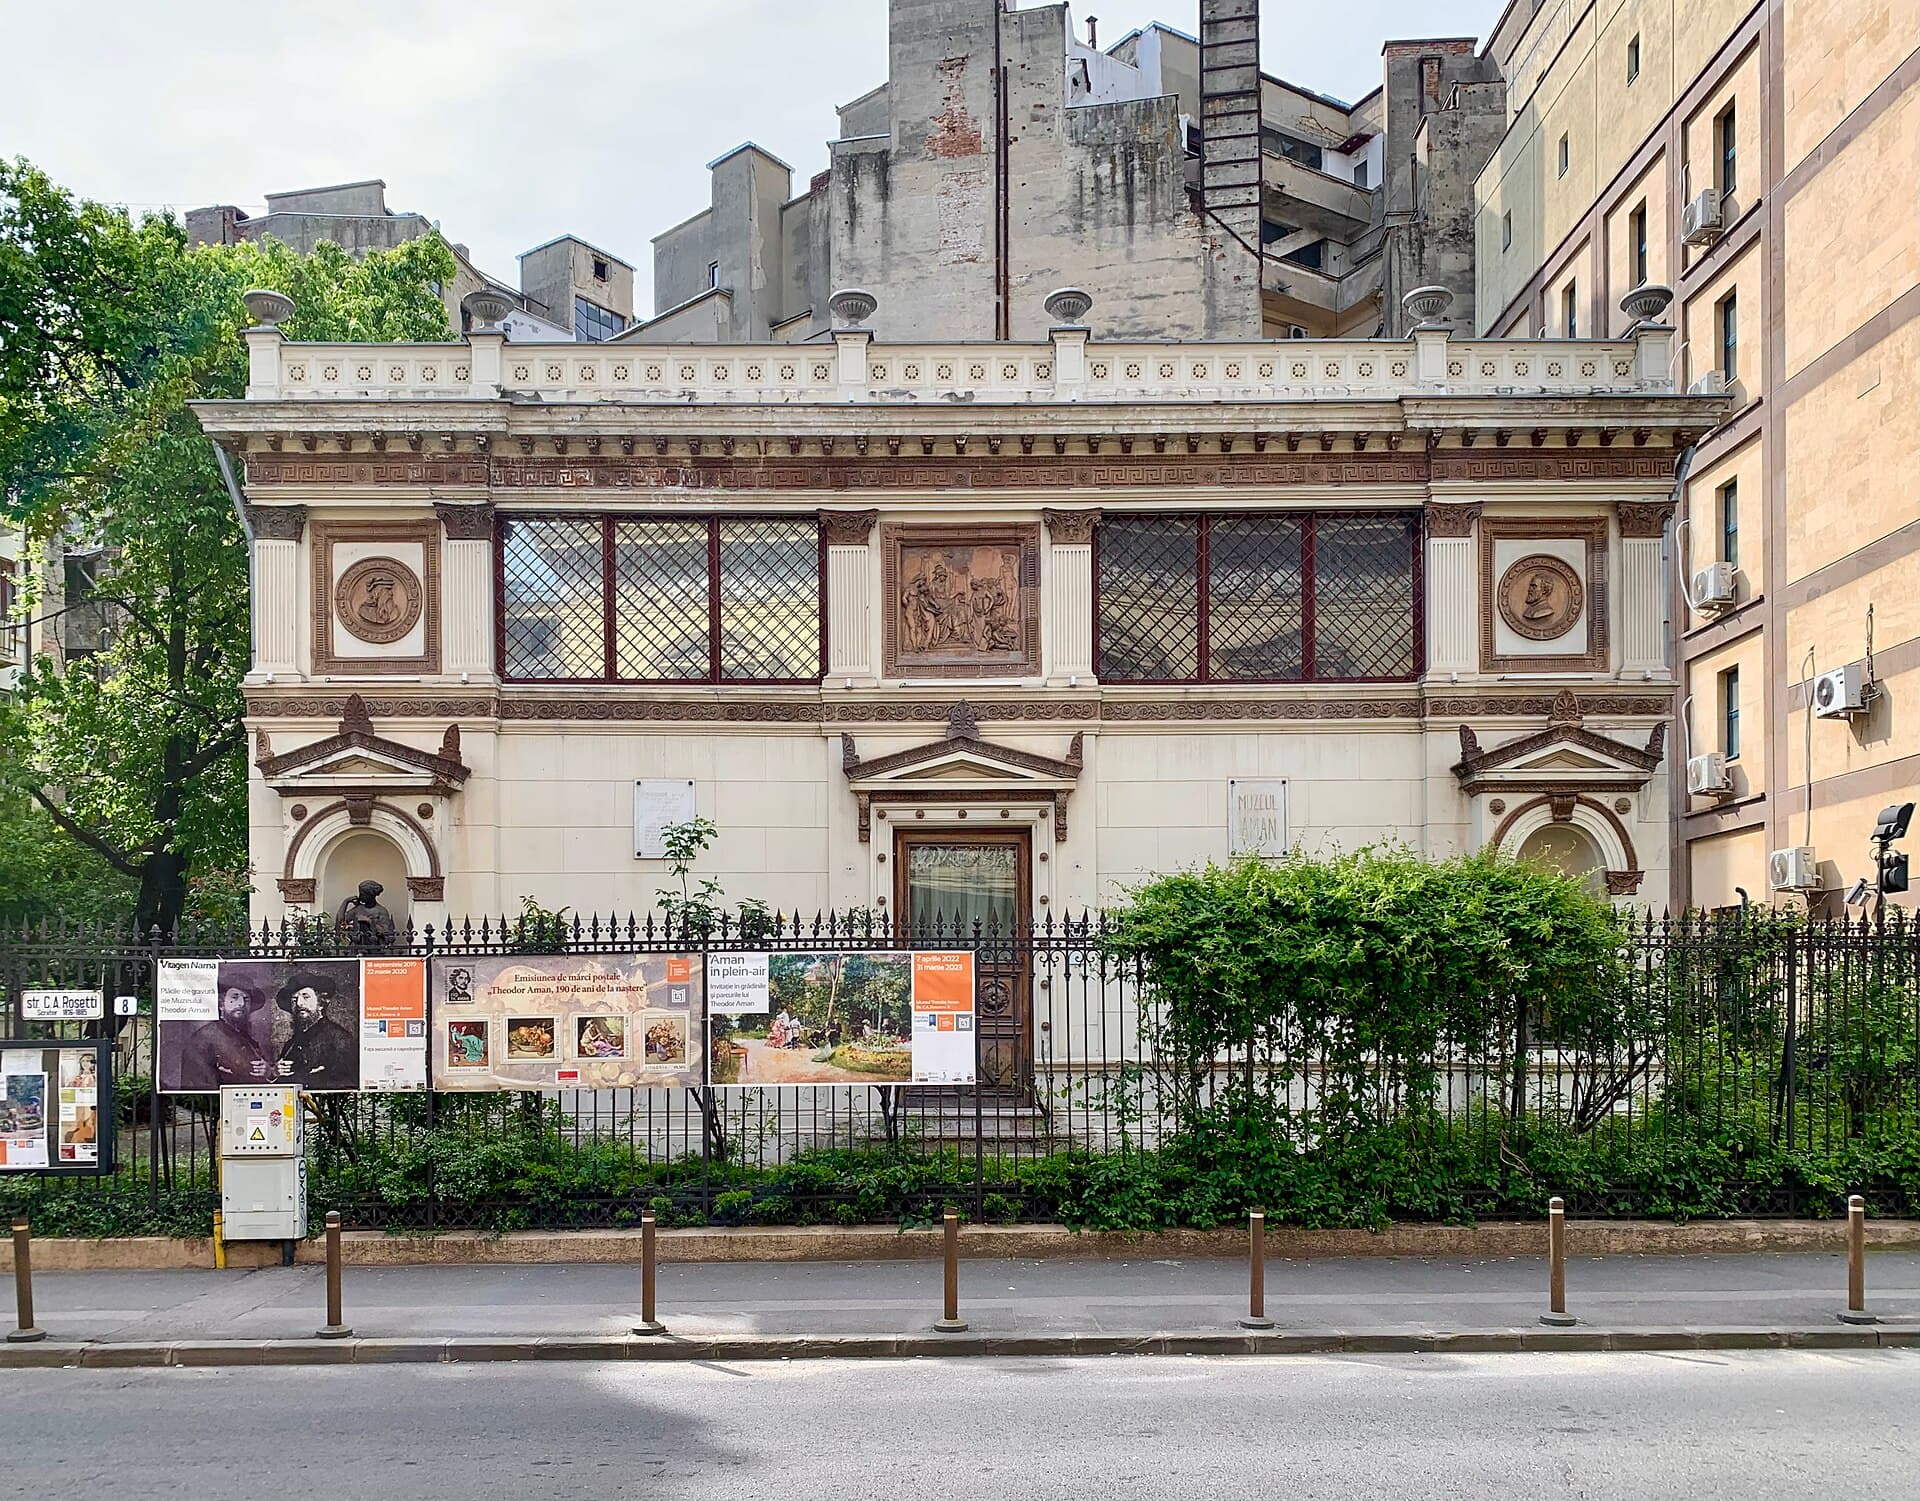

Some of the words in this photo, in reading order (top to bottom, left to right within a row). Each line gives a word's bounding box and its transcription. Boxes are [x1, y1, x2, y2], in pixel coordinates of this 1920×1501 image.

[710, 954, 745, 964] Aman
[191, 961, 216, 969] Nama
[514, 974, 556, 982] Emisiunea
[557, 973, 567, 982] de
[722, 966, 766, 979] plein-air
[527, 985, 554, 994] Aman,
[556, 985, 570, 993] 190
[571, 985, 581, 993] de
[582, 985, 595, 993] ani
[596, 984, 606, 993] de
[607, 984, 615, 993] la
[62, 995, 97, 1009] Rosetti
[122, 999, 129, 1013] 8
[160, 1006, 187, 1014] Theodor
[188, 1006, 210, 1014] Aman
